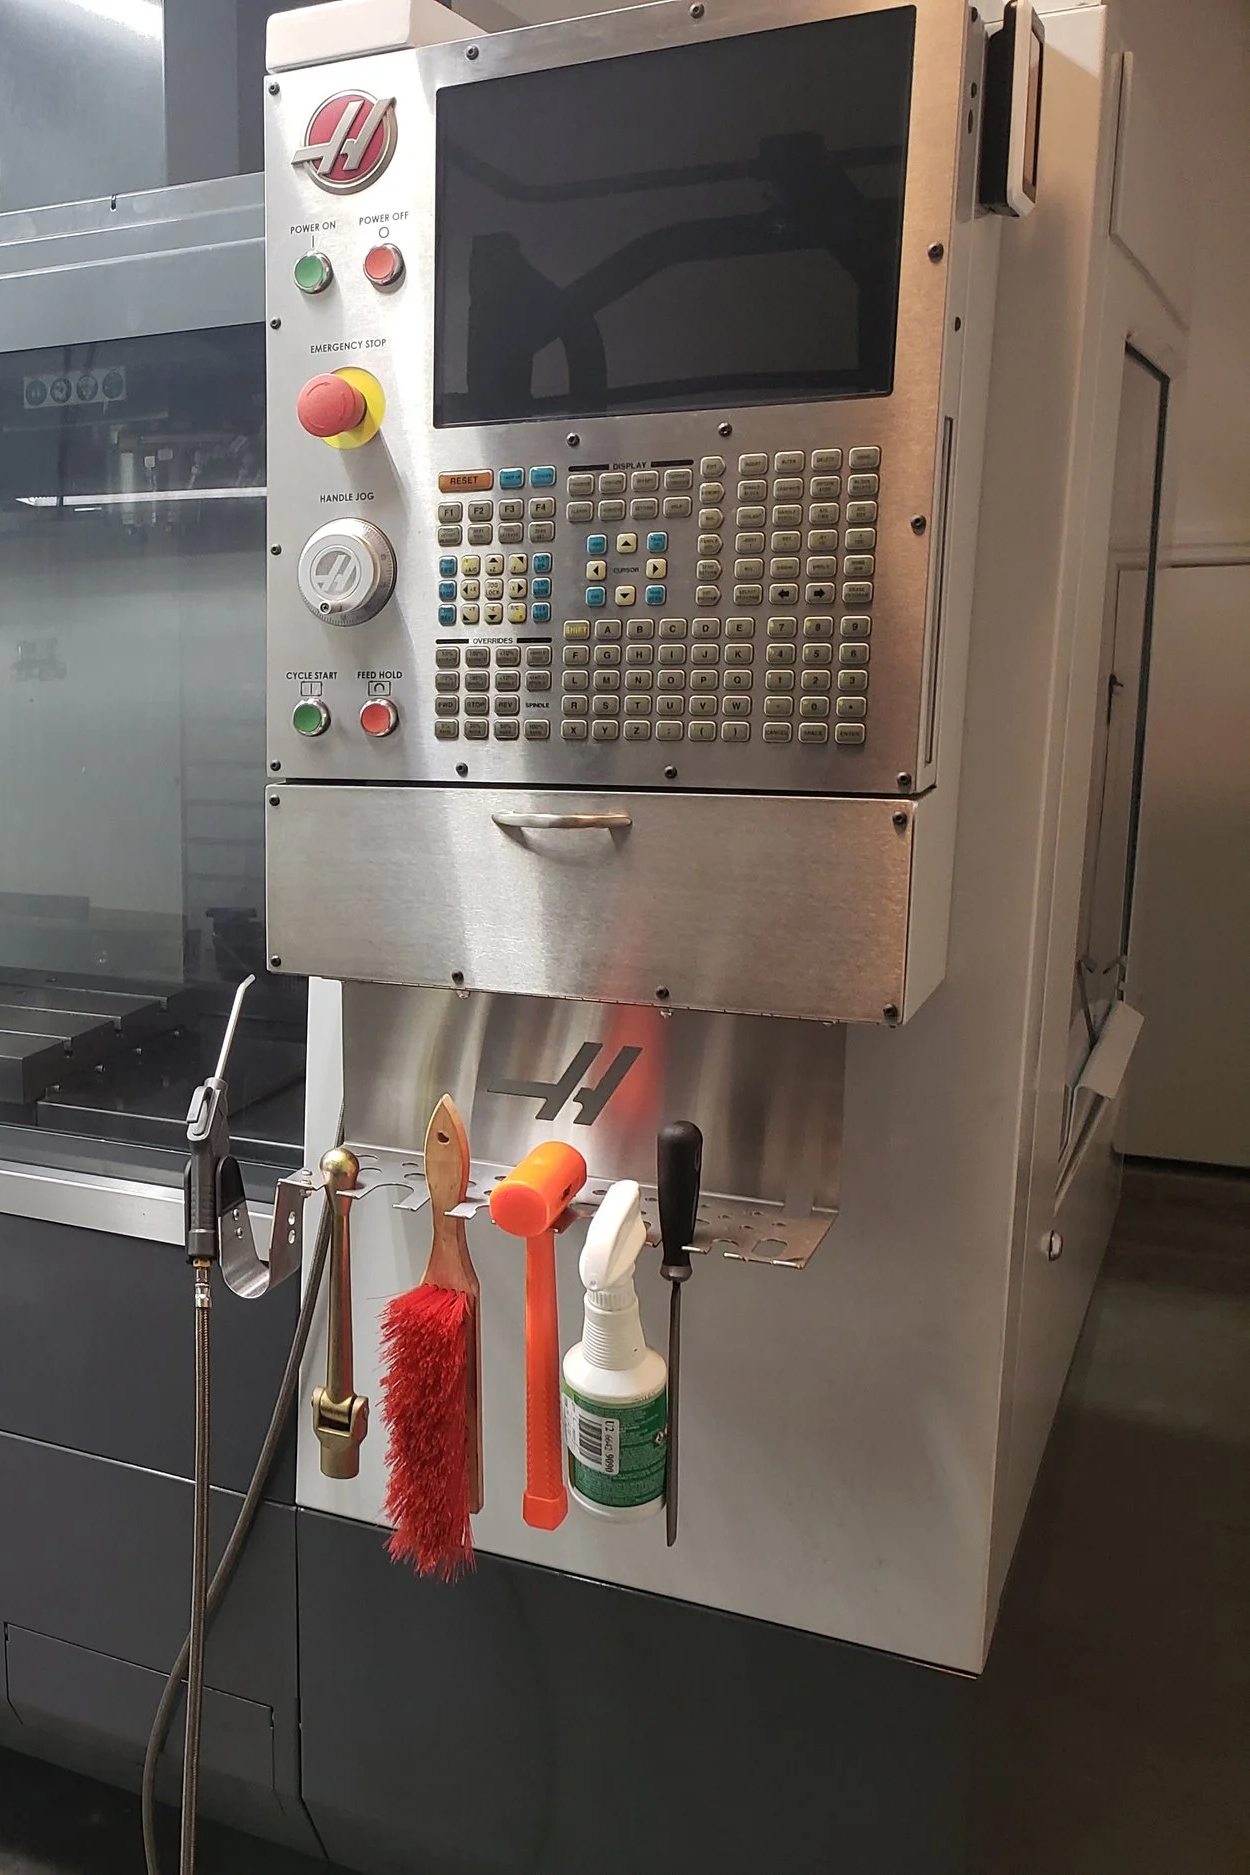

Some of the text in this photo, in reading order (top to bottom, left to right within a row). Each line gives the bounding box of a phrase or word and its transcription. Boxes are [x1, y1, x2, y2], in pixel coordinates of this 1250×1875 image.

[359, 211, 409, 226] POWER OFF
[290, 221, 336, 235] POWER ON
[310, 338, 387, 354] EMERGENCY STOP
[613, 462, 647, 470] DISPLAY
[450, 476, 478, 485] RESET
[320, 492, 374, 503] HANDLE JOG
[474, 507, 484, 515] F2
[505, 505, 515, 513] F3
[535, 504, 546, 512] F4
[566, 626, 587, 634] SHIFT
[604, 626, 611, 634] A
[636, 625, 643, 633] B
[669, 625, 676, 633] C
[702, 624, 709, 632] D
[736, 624, 742, 632] E
[778, 624, 785, 632] 7
[815, 623, 821, 631] 8
[852, 623, 859, 631] 9
[572, 651, 578, 659] F
[603, 651, 611, 659] G
[636, 651, 643, 659] H
[702, 650, 708, 658] J
[735, 650, 742, 658] K
[777, 650, 783, 658] 4
[813, 650, 820, 658] 5
[850, 650, 857, 658] 6
[286, 672, 312, 680] CYCLE
[357, 671, 403, 679] FEED HOLD
[572, 676, 577, 684] L
[603, 676, 610, 684] M
[635, 676, 642, 684] N
[700, 676, 707, 684] P
[733, 676, 741, 684] Q
[602, 701, 609, 710] S
[700, 702, 706, 710] V
[732, 702, 741, 710] W
[570, 726, 577, 734] X
[602, 726, 608, 734] Y
[604, 1421, 615, 1432] U2
[605, 1454, 615, 1473] 9090
